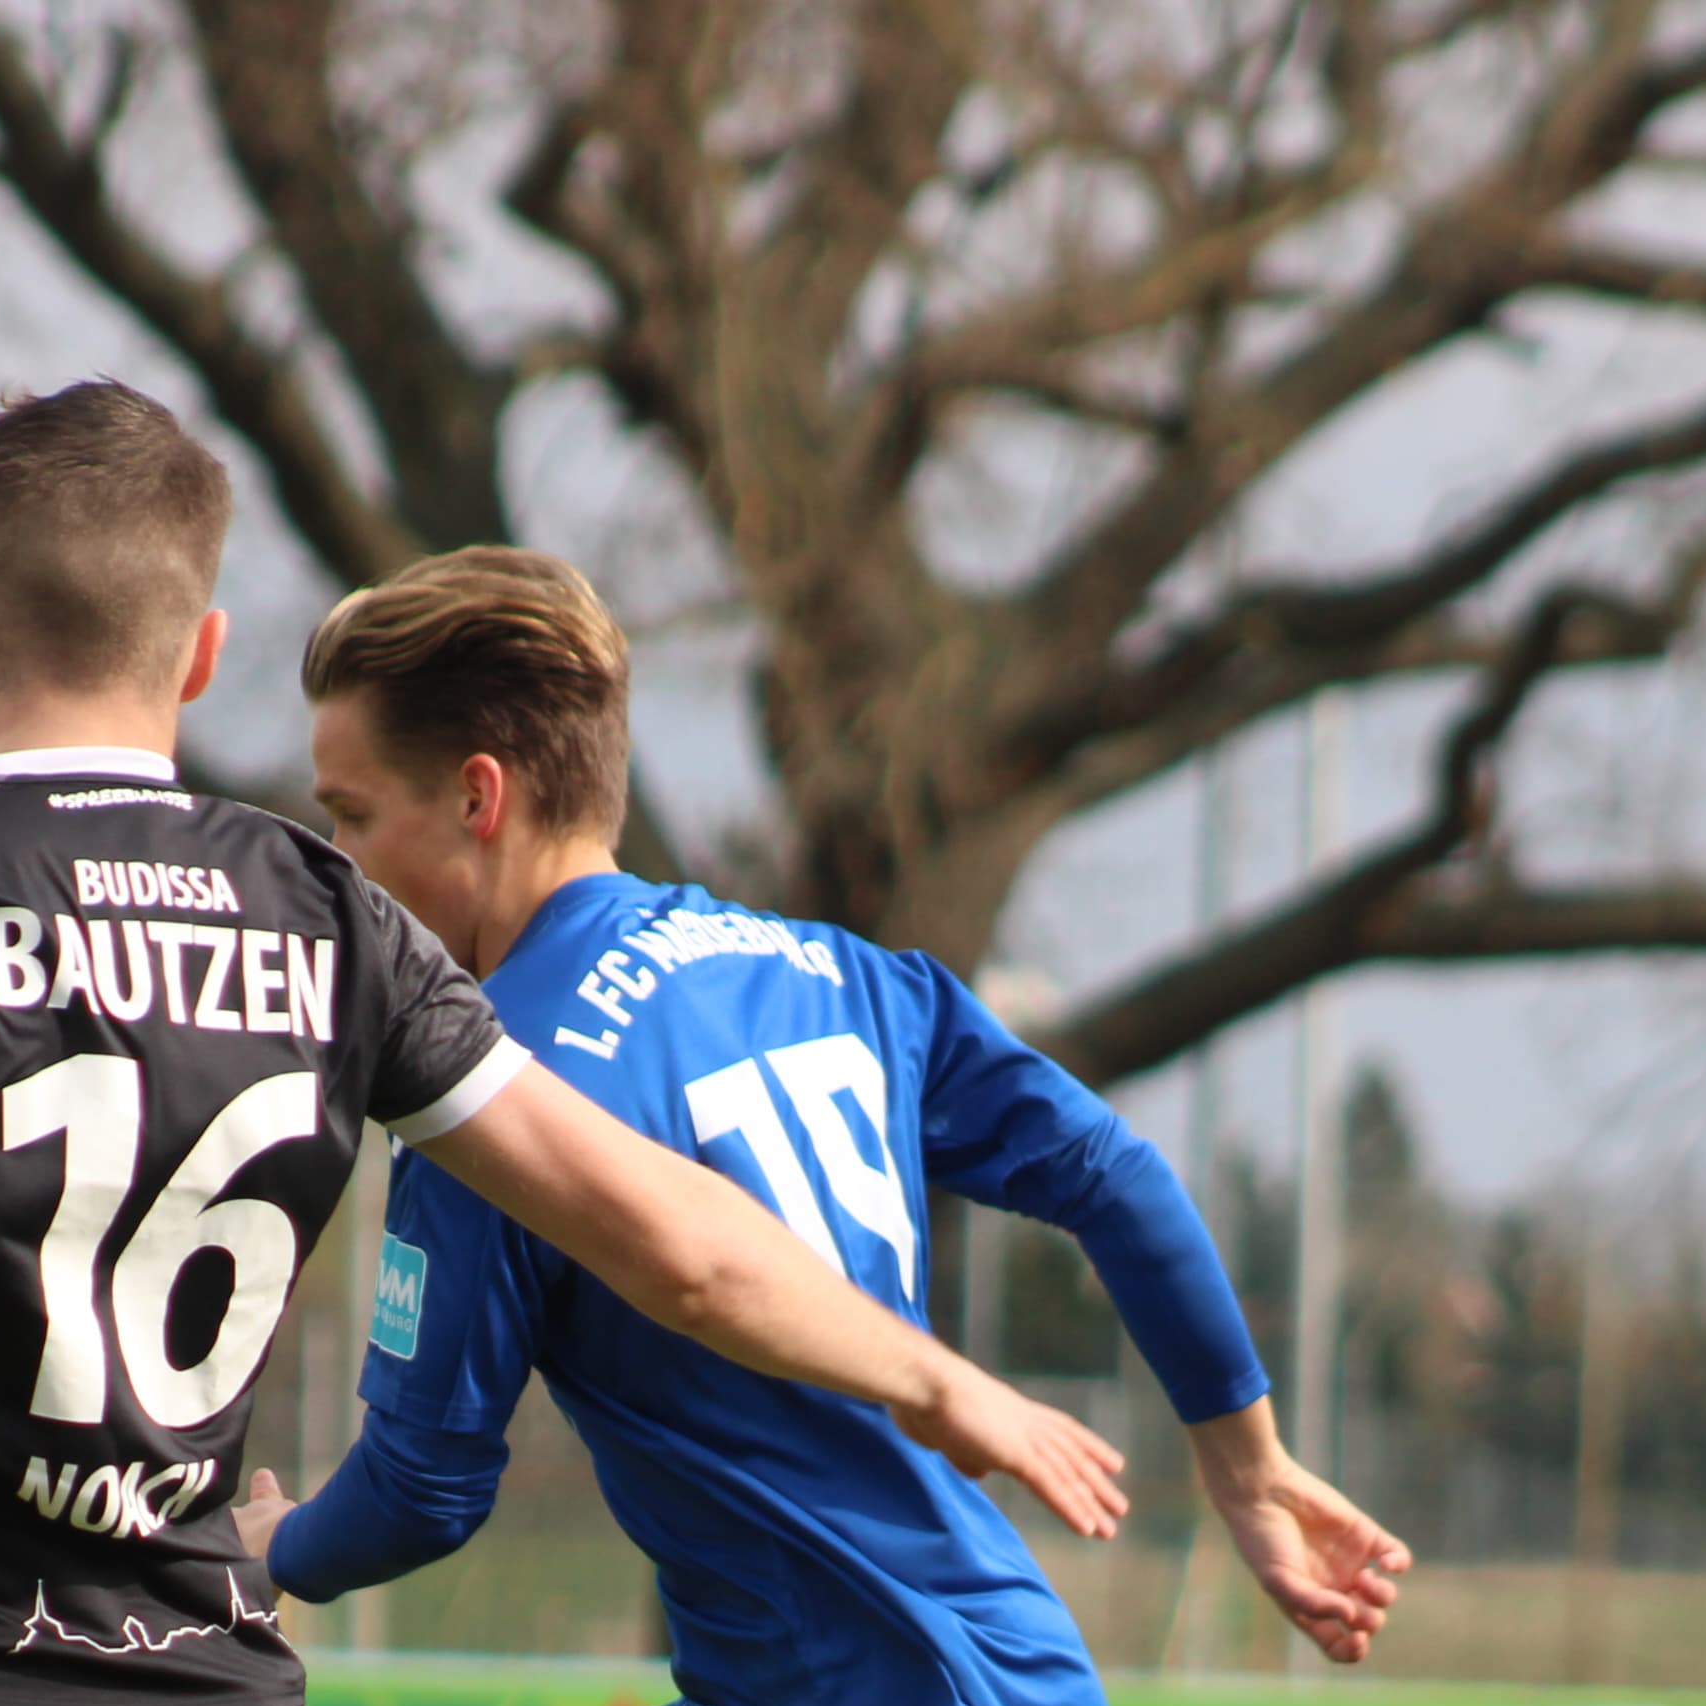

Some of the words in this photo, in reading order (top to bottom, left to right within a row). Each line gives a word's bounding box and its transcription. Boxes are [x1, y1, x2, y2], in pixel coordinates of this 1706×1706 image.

[73, 858, 241, 913] BUDISSA
[576, 948, 657, 1027] FC
[1, 1052, 319, 1430] 16
